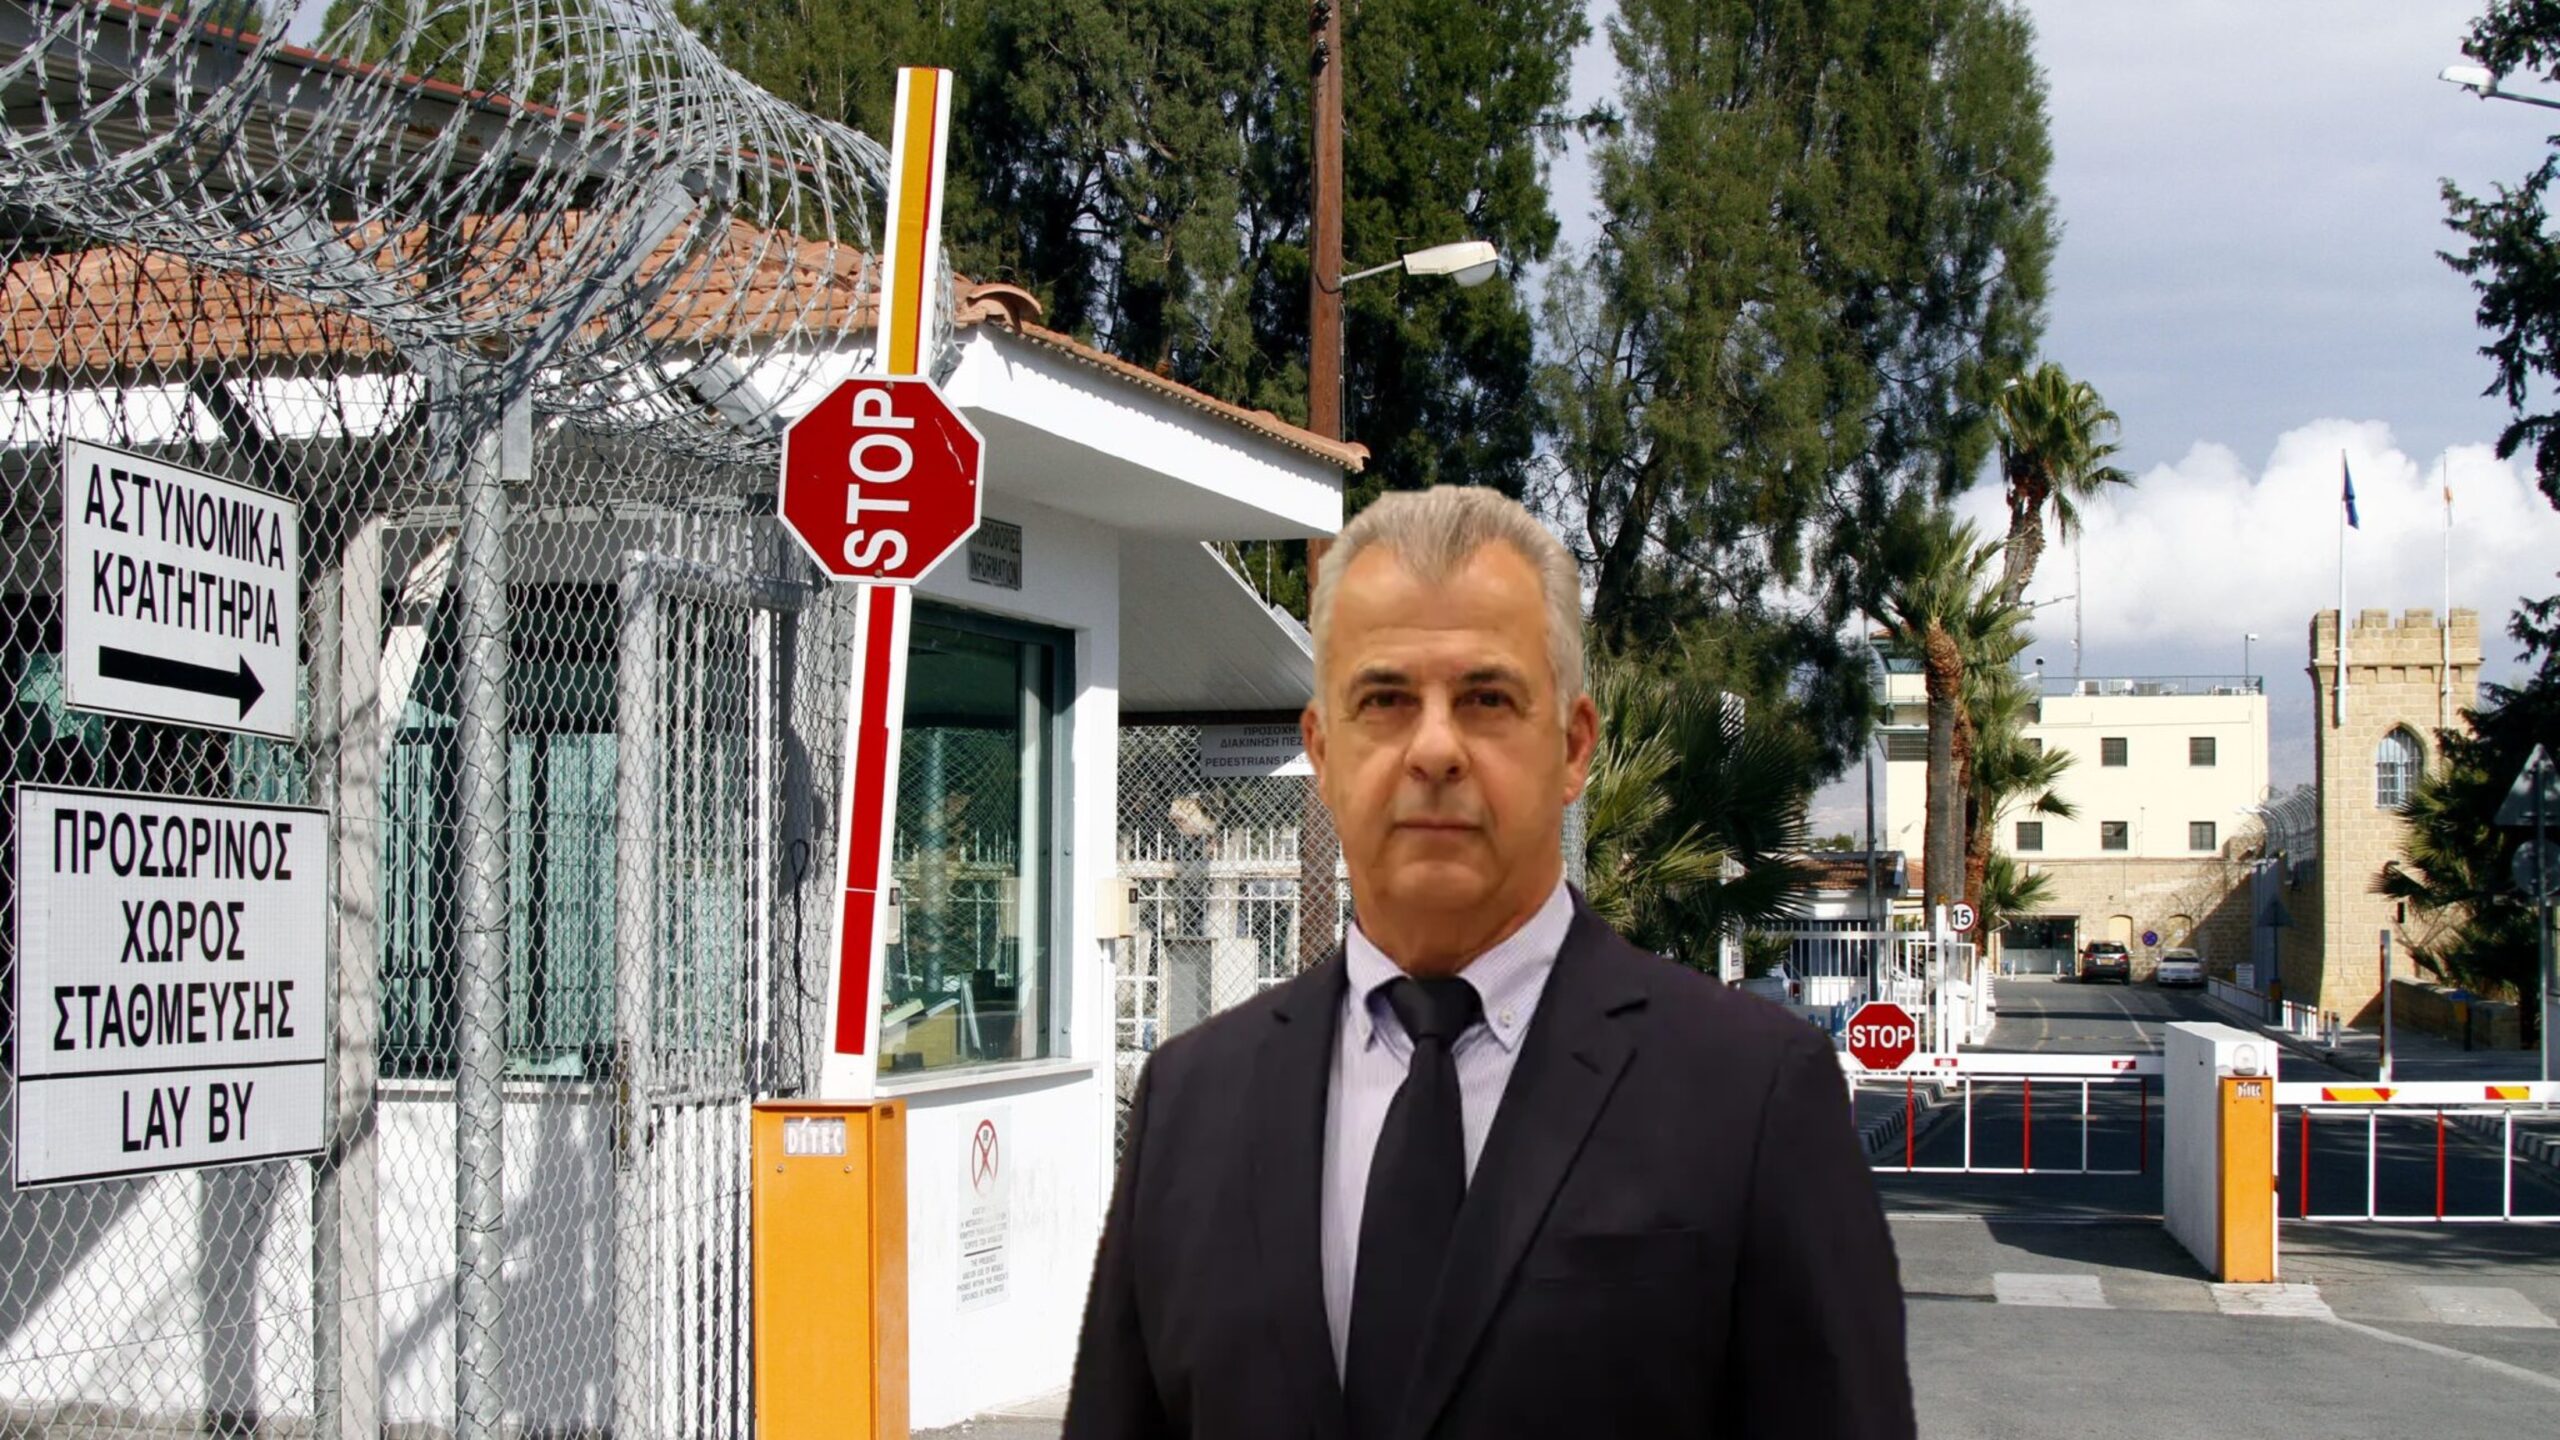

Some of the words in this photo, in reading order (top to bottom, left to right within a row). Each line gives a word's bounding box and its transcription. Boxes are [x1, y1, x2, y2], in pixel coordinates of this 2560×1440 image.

[843, 387, 915, 571] STOP
[84, 463, 285, 571] ΑΣΤΥΝΟΜΙΚΑ
[93, 549, 281, 647] ΚΡΑΤΗΤΗΡΙΑ
[1205, 755, 1281, 768] PEDESTRIANS
[1220, 736, 1279, 748] ΔΙΑΚΙΝΗΣΗ
[1282, 735, 1304, 747] ΠΕΖ
[54, 808, 292, 881] ΠΡΟΣΩΡΙΝΟΣ
[120, 899, 245, 963] ΧΩΡΟΣ
[1953, 908, 1972, 926] 15
[53, 980, 295, 1051] ΣΤΑΘΜΕΥΣΗΣ
[1851, 1025, 1912, 1048] STOP
[121, 1086, 191, 1153] LAY
[208, 1081, 254, 1144] BY
